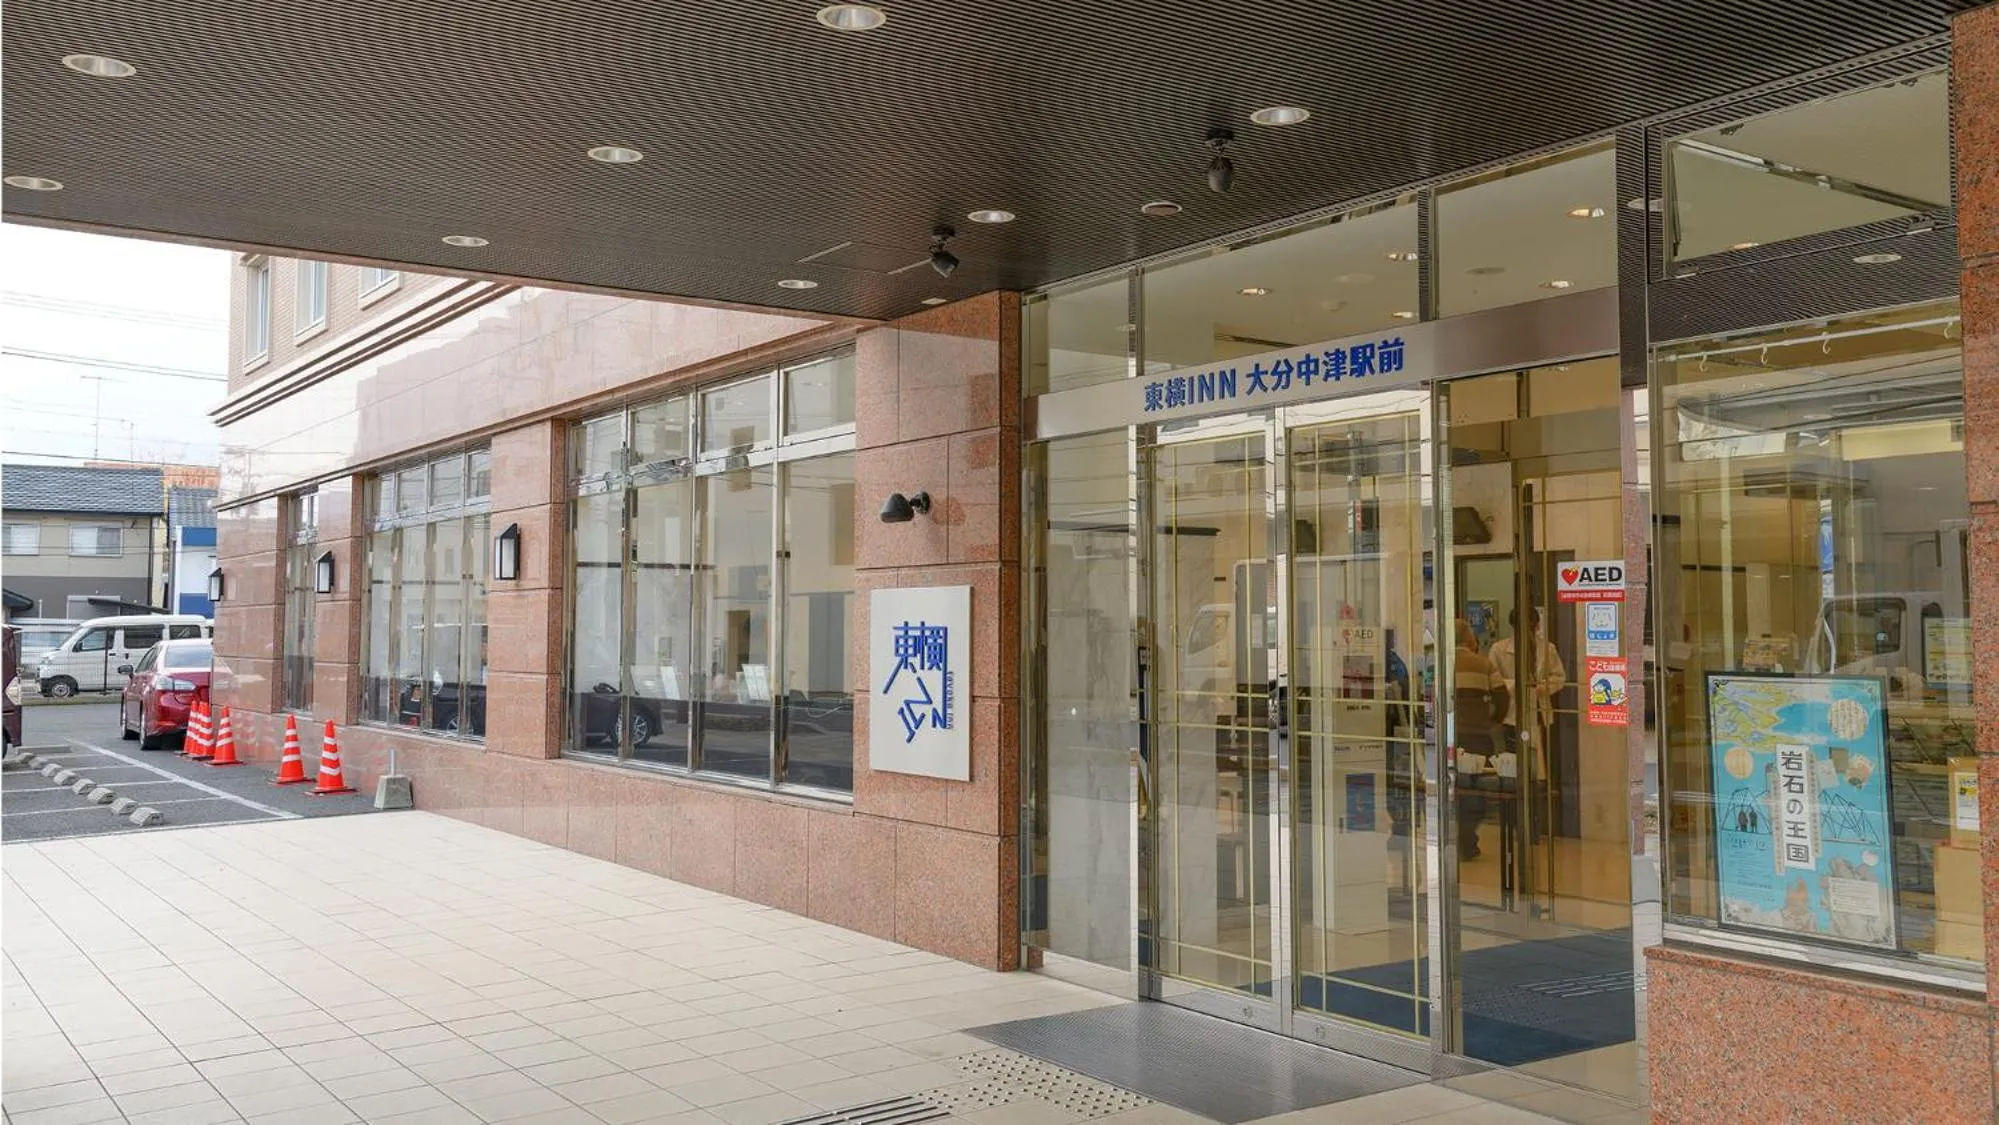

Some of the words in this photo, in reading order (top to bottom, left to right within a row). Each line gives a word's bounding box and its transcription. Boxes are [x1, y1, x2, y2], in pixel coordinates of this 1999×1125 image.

[1143, 367, 1237, 412] 東横INN
[1245, 336, 1405, 396] 大分中津駅前
[1579, 566, 1623, 582] AED
[1354, 629, 1374, 640] AED
[1780, 749, 1810, 863] 岩石の王国
